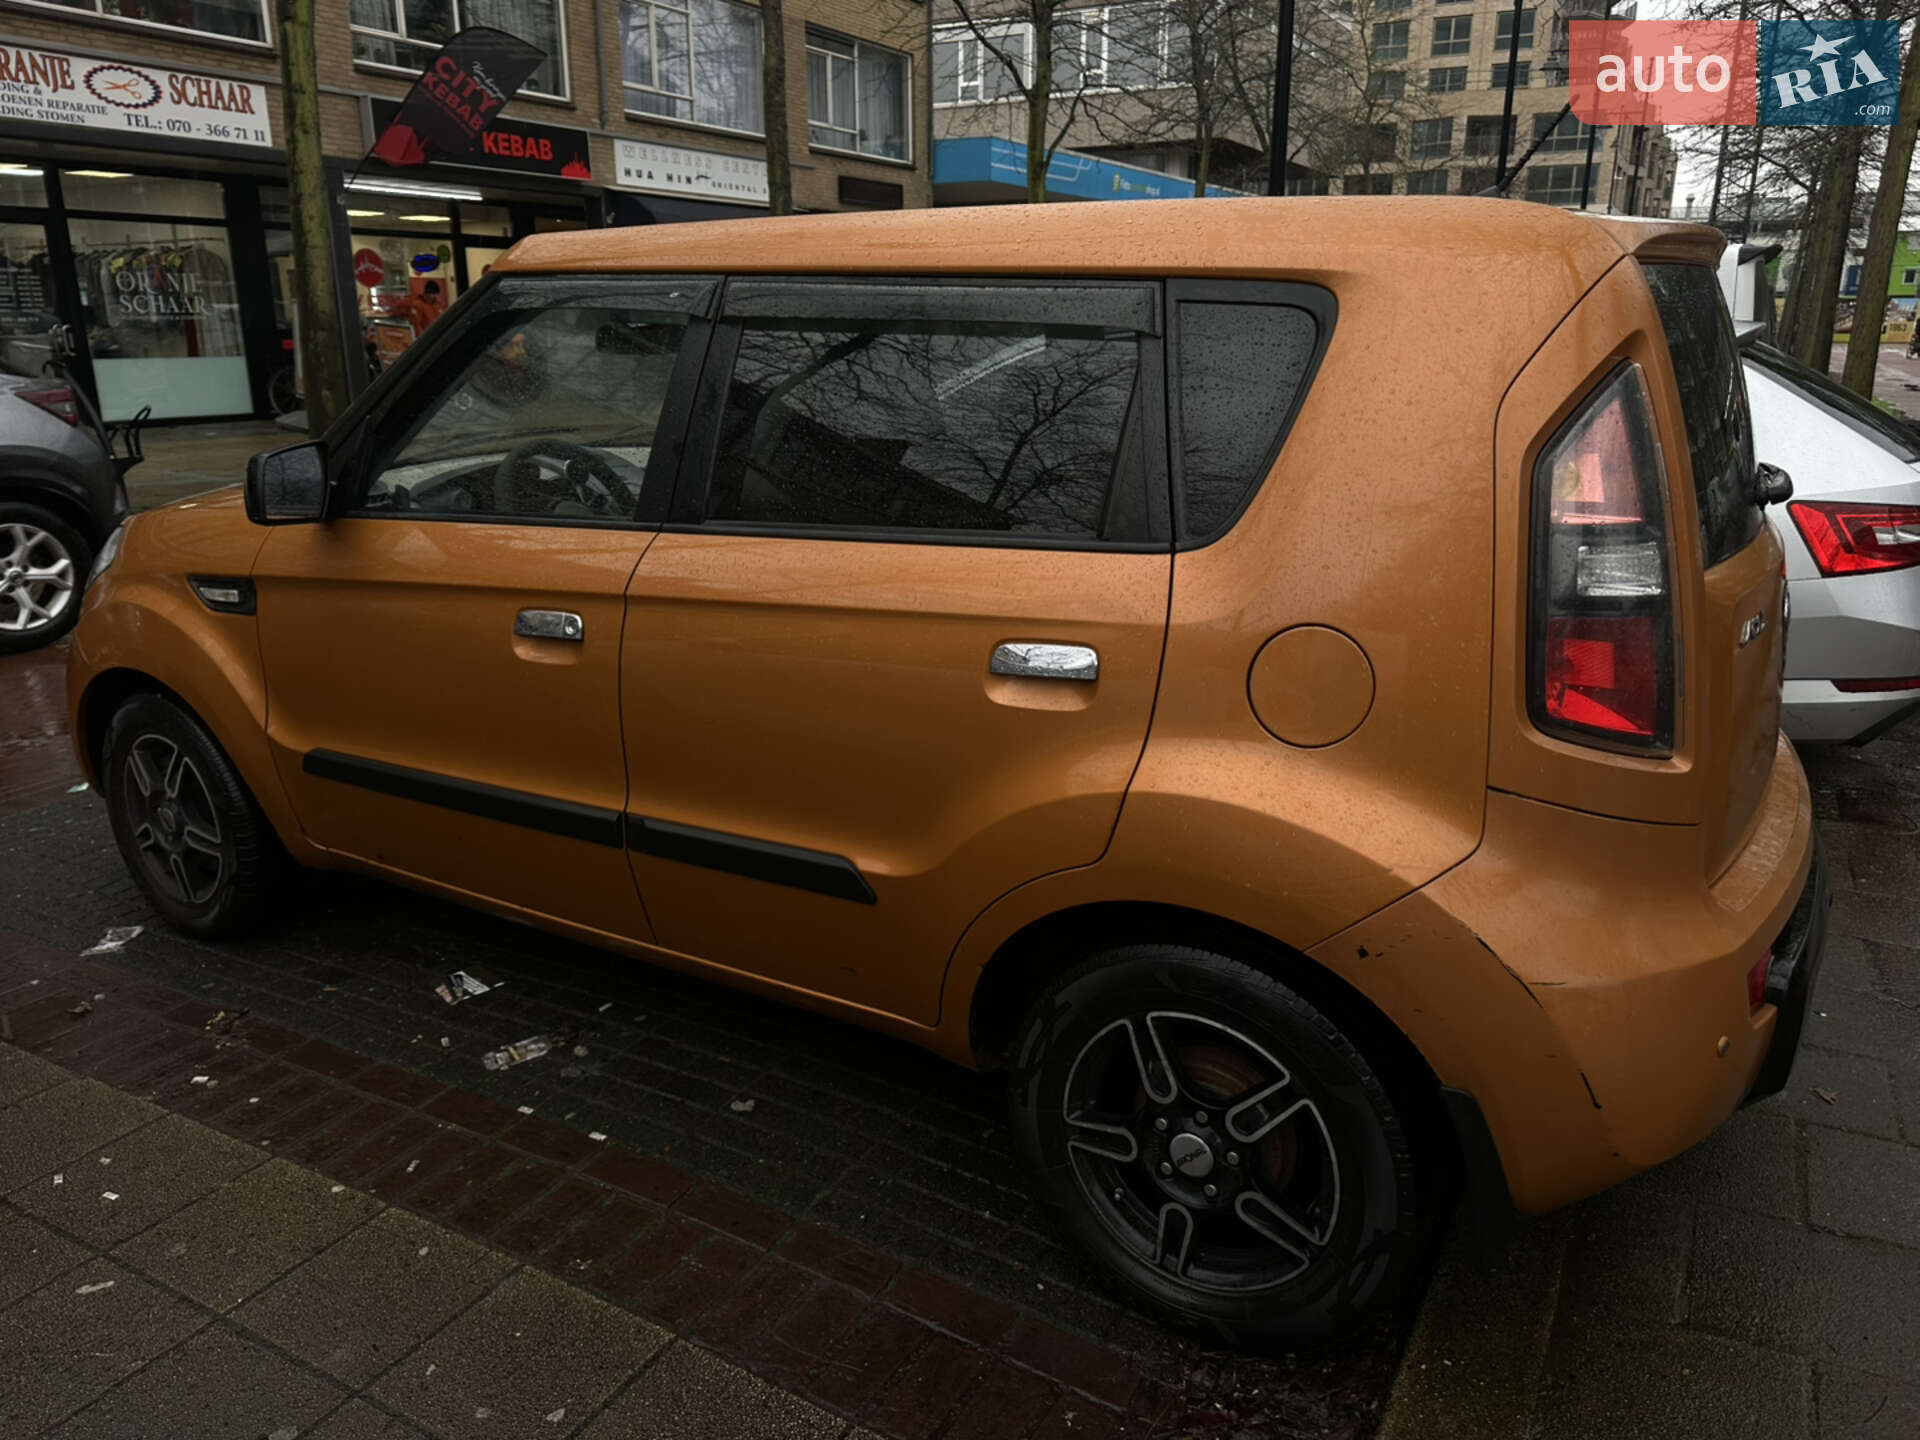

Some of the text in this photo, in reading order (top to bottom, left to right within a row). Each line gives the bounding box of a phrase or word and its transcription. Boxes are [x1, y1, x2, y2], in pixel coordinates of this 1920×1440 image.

[33, 86, 42, 95] &
[168, 73, 255, 115] SCHAAR
[436, 56, 499, 113] CITY
[47, 99, 108, 116] REPARATIE
[423, 71, 485, 131] KEBAB
[37, 109, 86, 124] STOMEN
[123, 112, 163, 130] TEL.:
[166, 118, 192, 133] 070
[205, 123, 230, 138] 366
[234, 127, 248, 140] 71
[254, 129, 266, 142] 11
[482, 131, 553, 161] KEBAB
[624, 167, 693, 185] HUA HIN
[119, 294, 209, 316] SCHAAR
